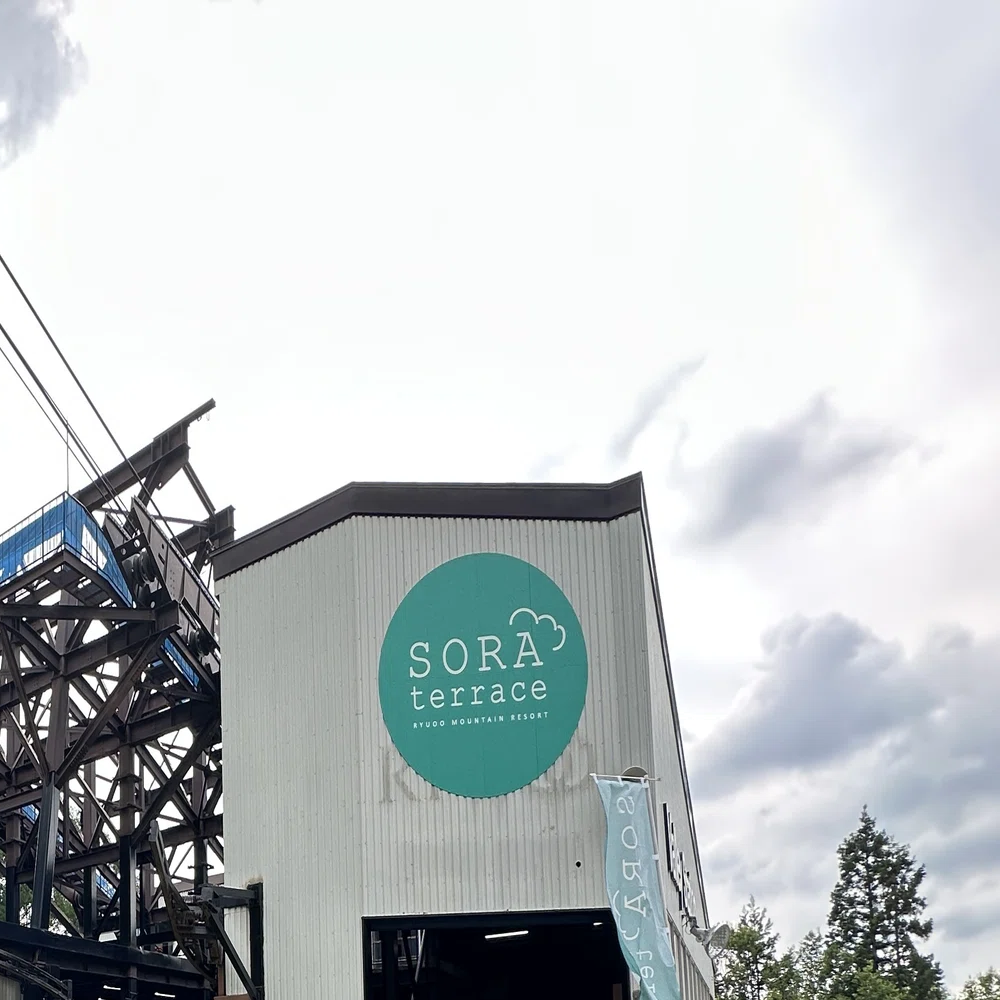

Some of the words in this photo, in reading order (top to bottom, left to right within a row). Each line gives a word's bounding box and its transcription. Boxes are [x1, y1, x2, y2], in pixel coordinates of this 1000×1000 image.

[409, 631, 544, 679] SORA
[410, 679, 547, 711] terrace
[413, 720, 446, 729] RYUOO
[451, 715, 504, 726] MOUNTAIN
[510, 711, 549, 721] RESORT
